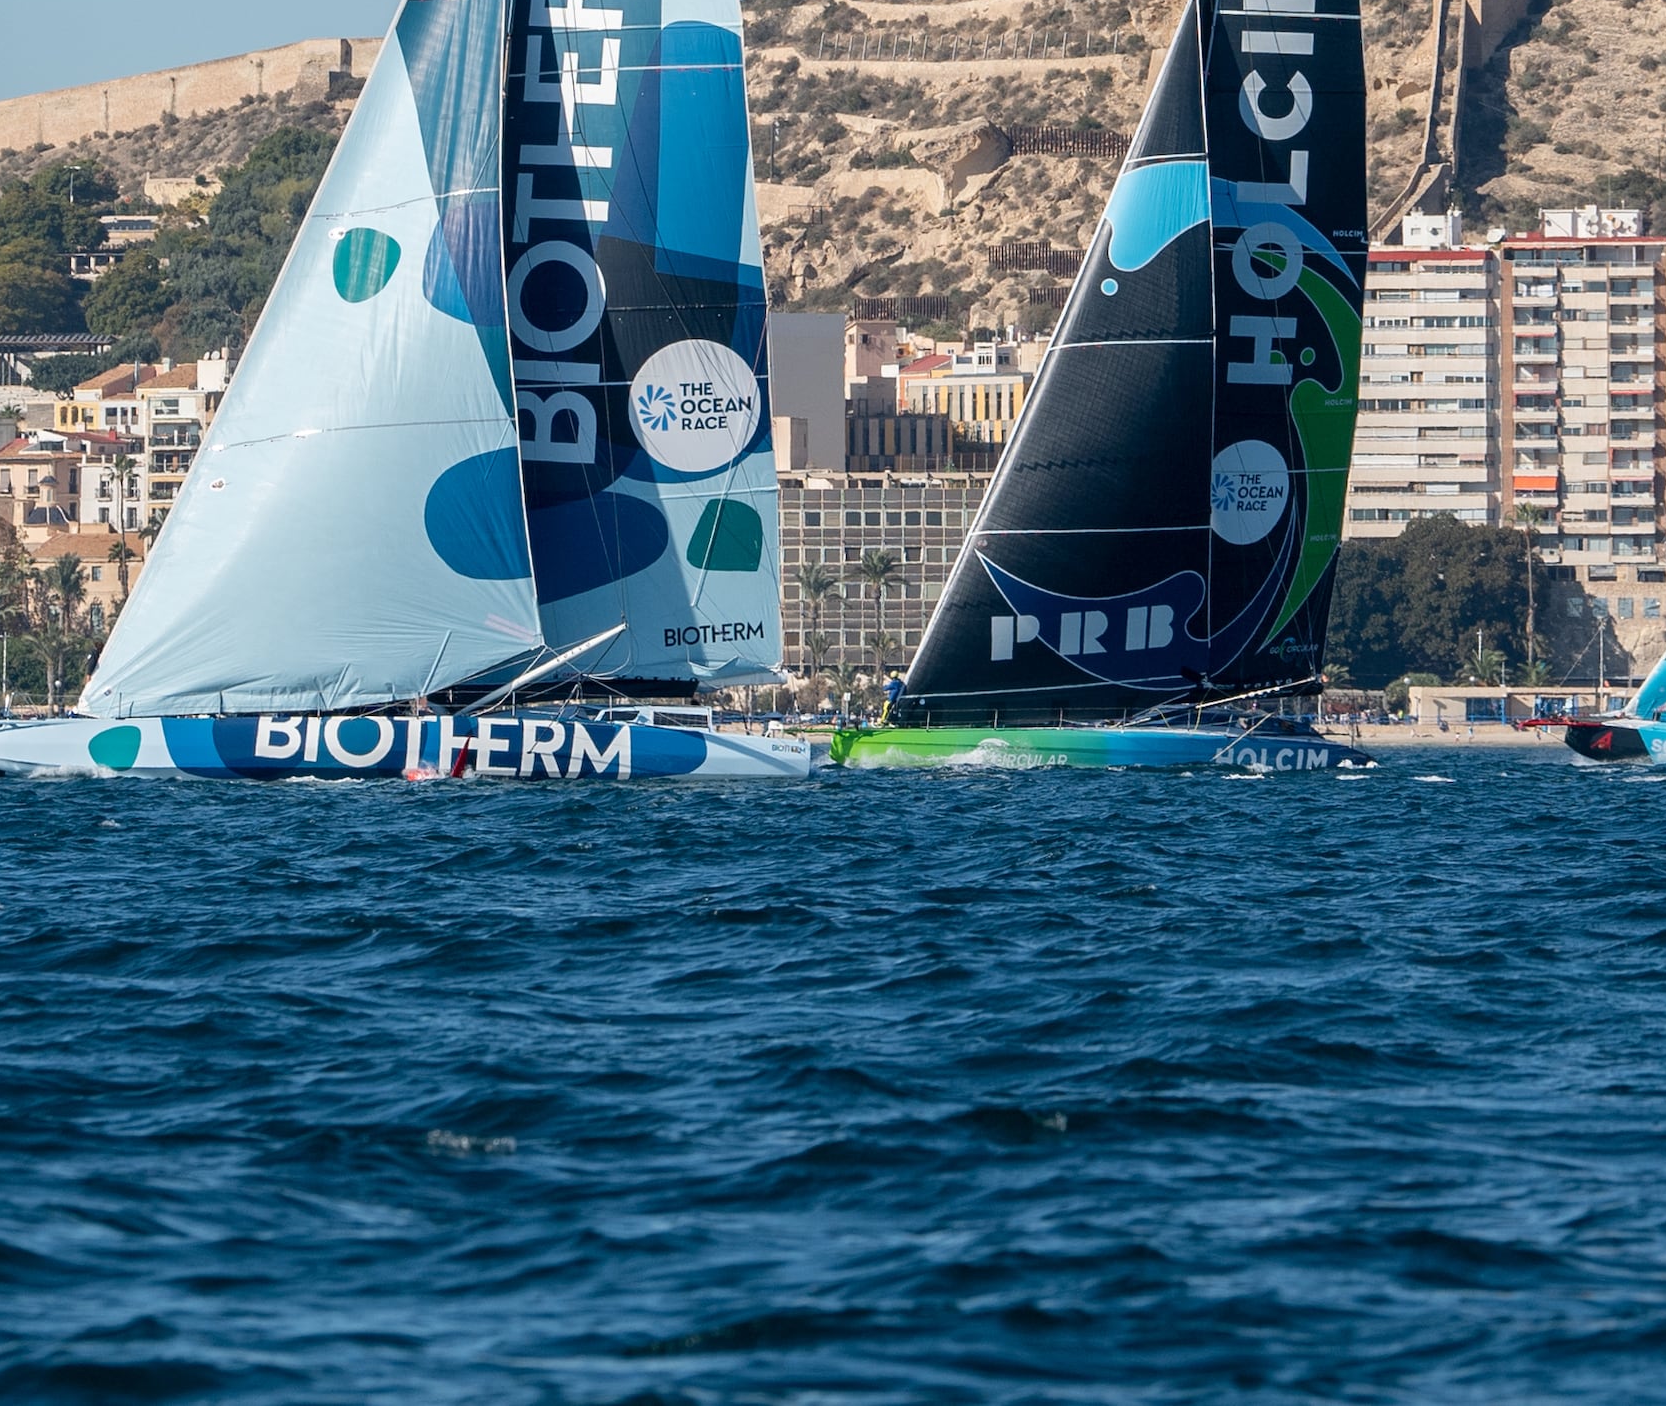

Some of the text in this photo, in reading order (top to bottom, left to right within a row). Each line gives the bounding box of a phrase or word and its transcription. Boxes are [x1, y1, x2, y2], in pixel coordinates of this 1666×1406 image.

[1332, 229, 1364, 238] HOLCIM
[679, 382, 713, 397] THE
[680, 396, 752, 415] OCEAN
[681, 416, 728, 431] RACE
[1238, 473, 1261, 485] THE
[1237, 485, 1284, 499] OCEAN
[1236, 500, 1268, 512] RACE
[664, 621, 765, 647] BIOTHERM
[253, 715, 633, 781] BIOTHERM
